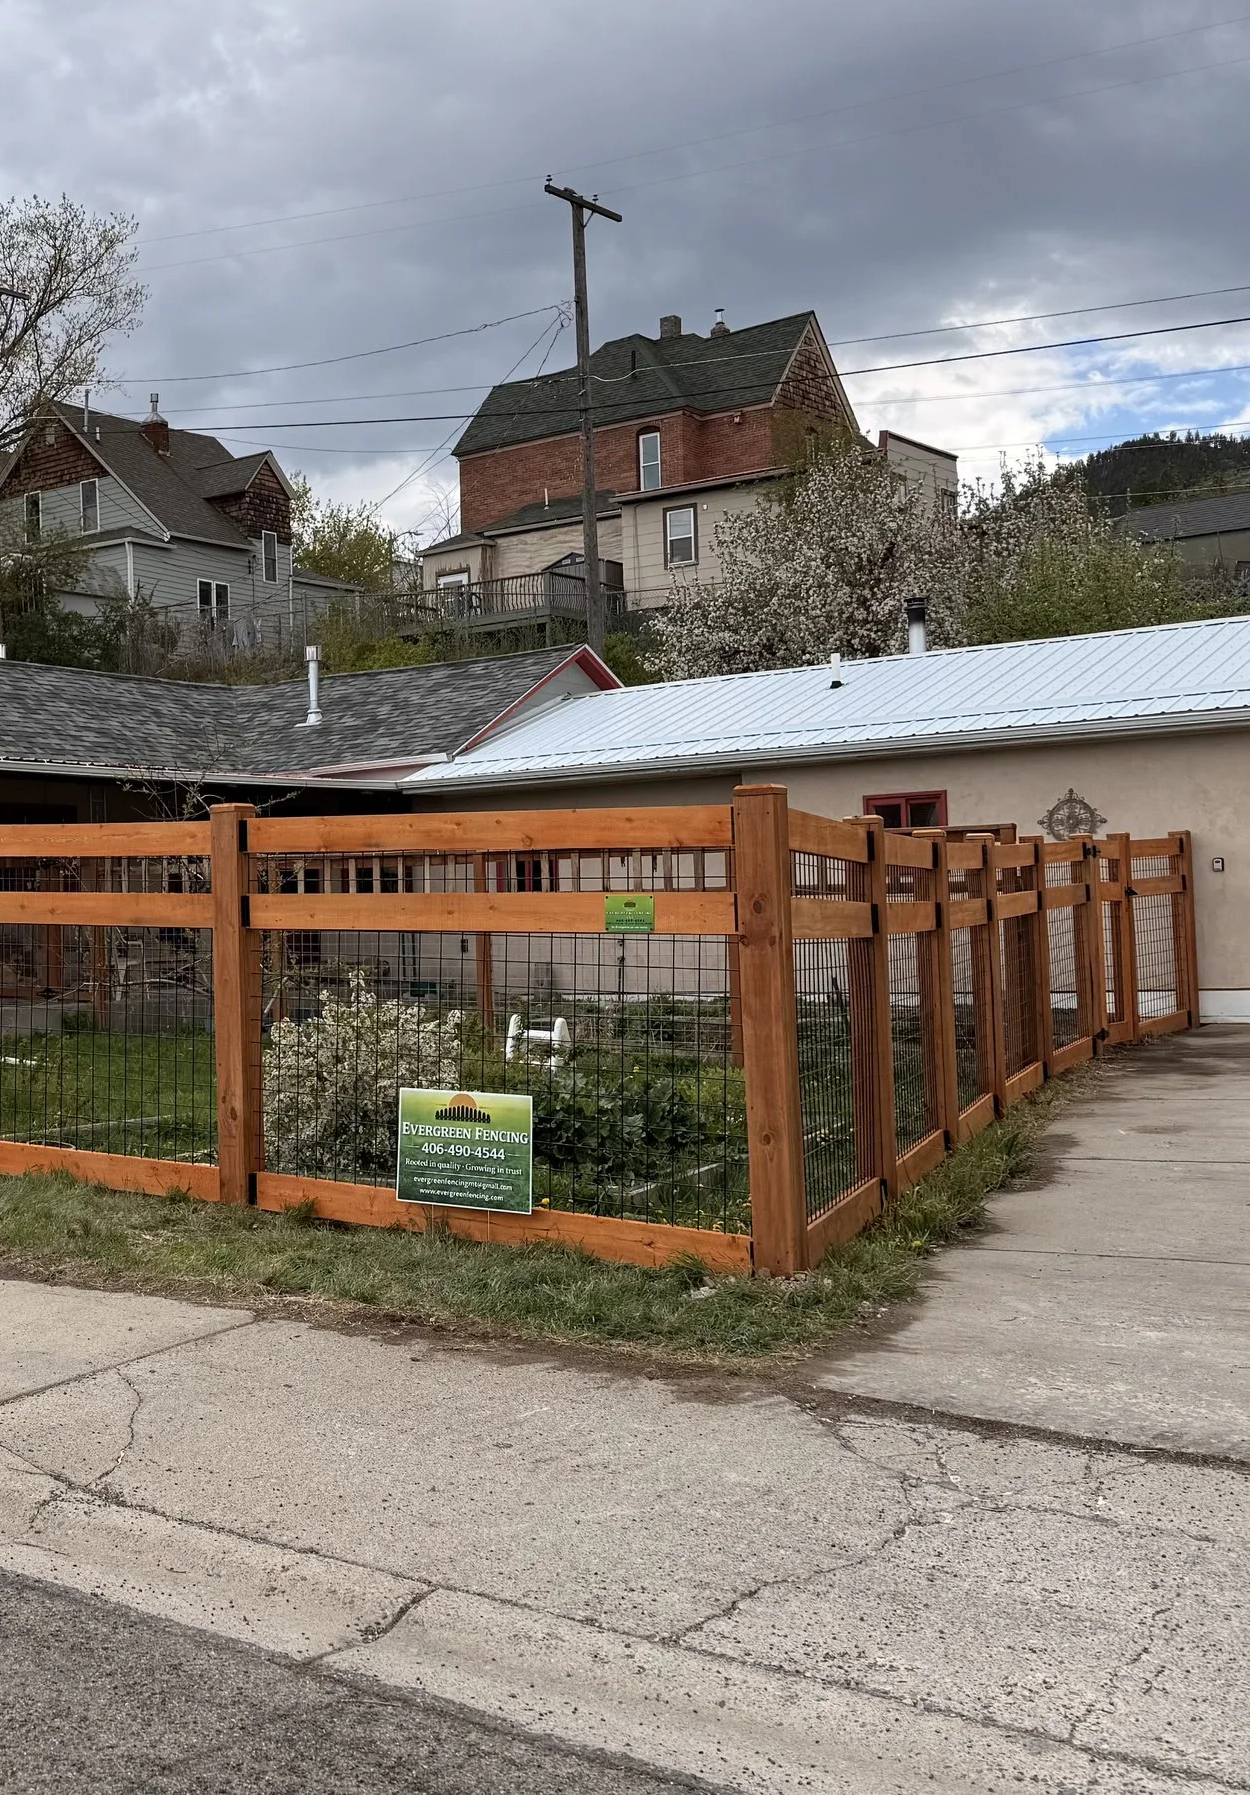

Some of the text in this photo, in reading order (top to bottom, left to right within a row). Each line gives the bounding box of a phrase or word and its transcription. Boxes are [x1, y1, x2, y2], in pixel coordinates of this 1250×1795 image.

[402, 1121, 529, 1144] EVERGREEN FENCING
[421, 1142, 505, 1160] 406-490-4544
[405, 1158, 428, 1167] Rooted
[429, 1159, 436, 1168] in
[437, 1161, 461, 1171] quality
[465, 1163, 496, 1175] Growing
[506, 1167, 522, 1175] trust
[413, 1176, 512, 1191] evergreenfencingmt@gmail.com
[419, 1188, 504, 1201] www.evergreenfencing.com
